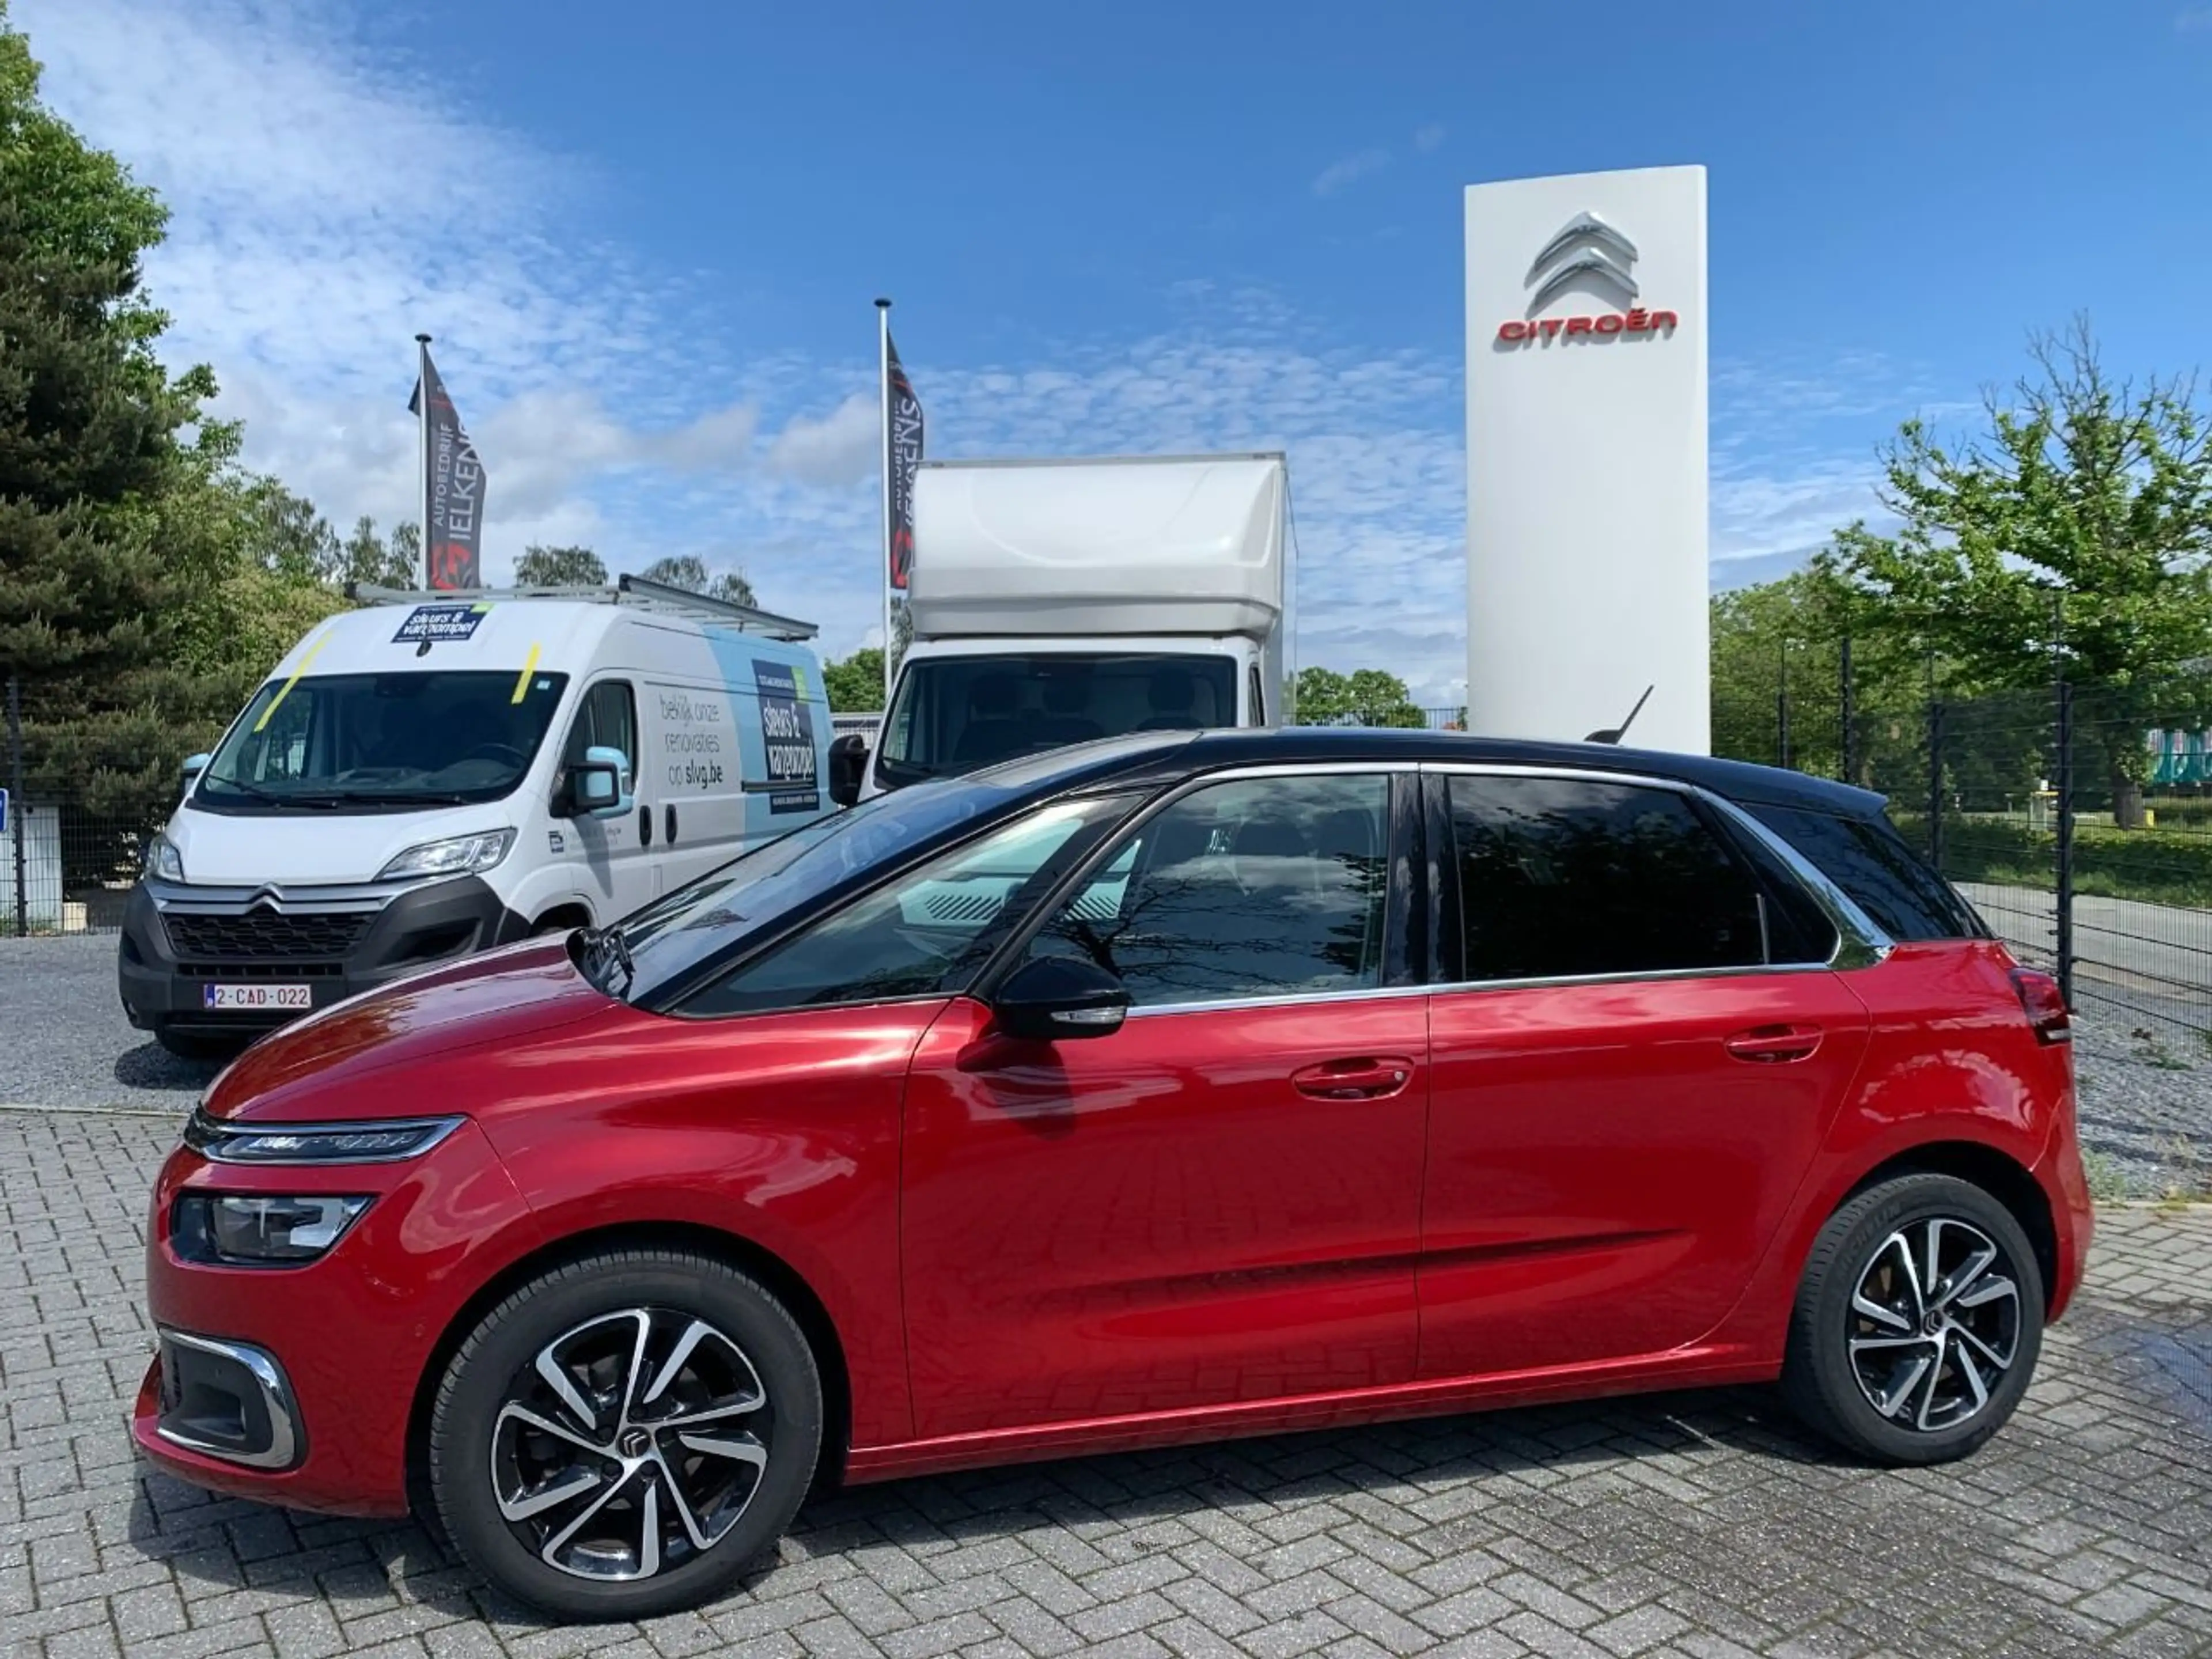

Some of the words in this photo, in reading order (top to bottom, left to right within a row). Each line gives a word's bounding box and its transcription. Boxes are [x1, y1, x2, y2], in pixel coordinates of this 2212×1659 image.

[1498, 307, 1678, 341] CITROËN
[433, 422, 454, 527] AUTOBEDRIJF
[695, 702, 720, 722] onze
[664, 729, 720, 753] renovaties
[668, 764, 683, 786] op
[685, 758, 724, 789] slvg.be
[216, 988, 308, 1005] 2-CAD-022
